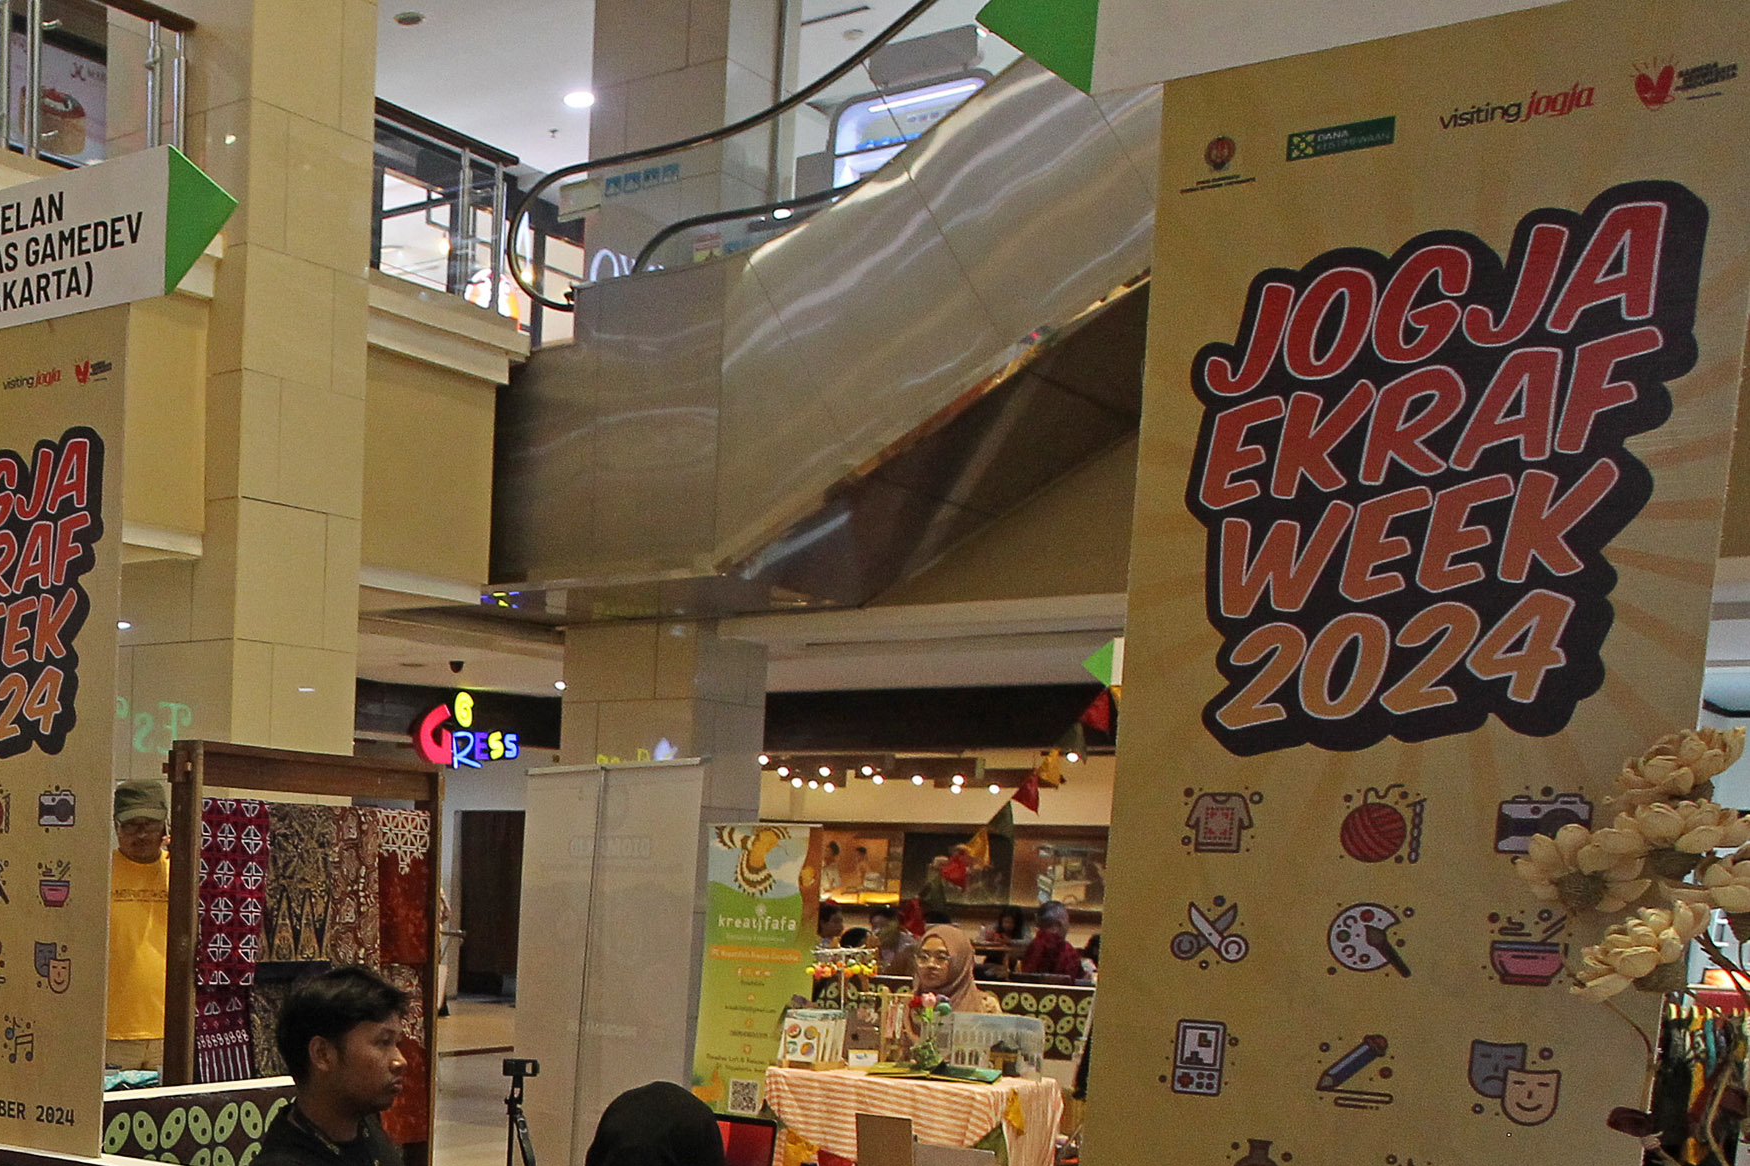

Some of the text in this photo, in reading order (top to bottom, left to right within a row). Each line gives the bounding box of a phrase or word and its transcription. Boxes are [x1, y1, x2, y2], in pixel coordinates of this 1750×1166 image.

[1440, 82, 1595, 129] visiting jogja
[25, 212, 144, 270] GAMEDEV
[1203, 201, 1668, 397] JOGJA
[1199, 326, 1663, 510] EKRAF
[1219, 457, 1619, 619] WEEK
[1215, 588, 1576, 730] 2024
[36, 1104, 75, 1126] 2024
